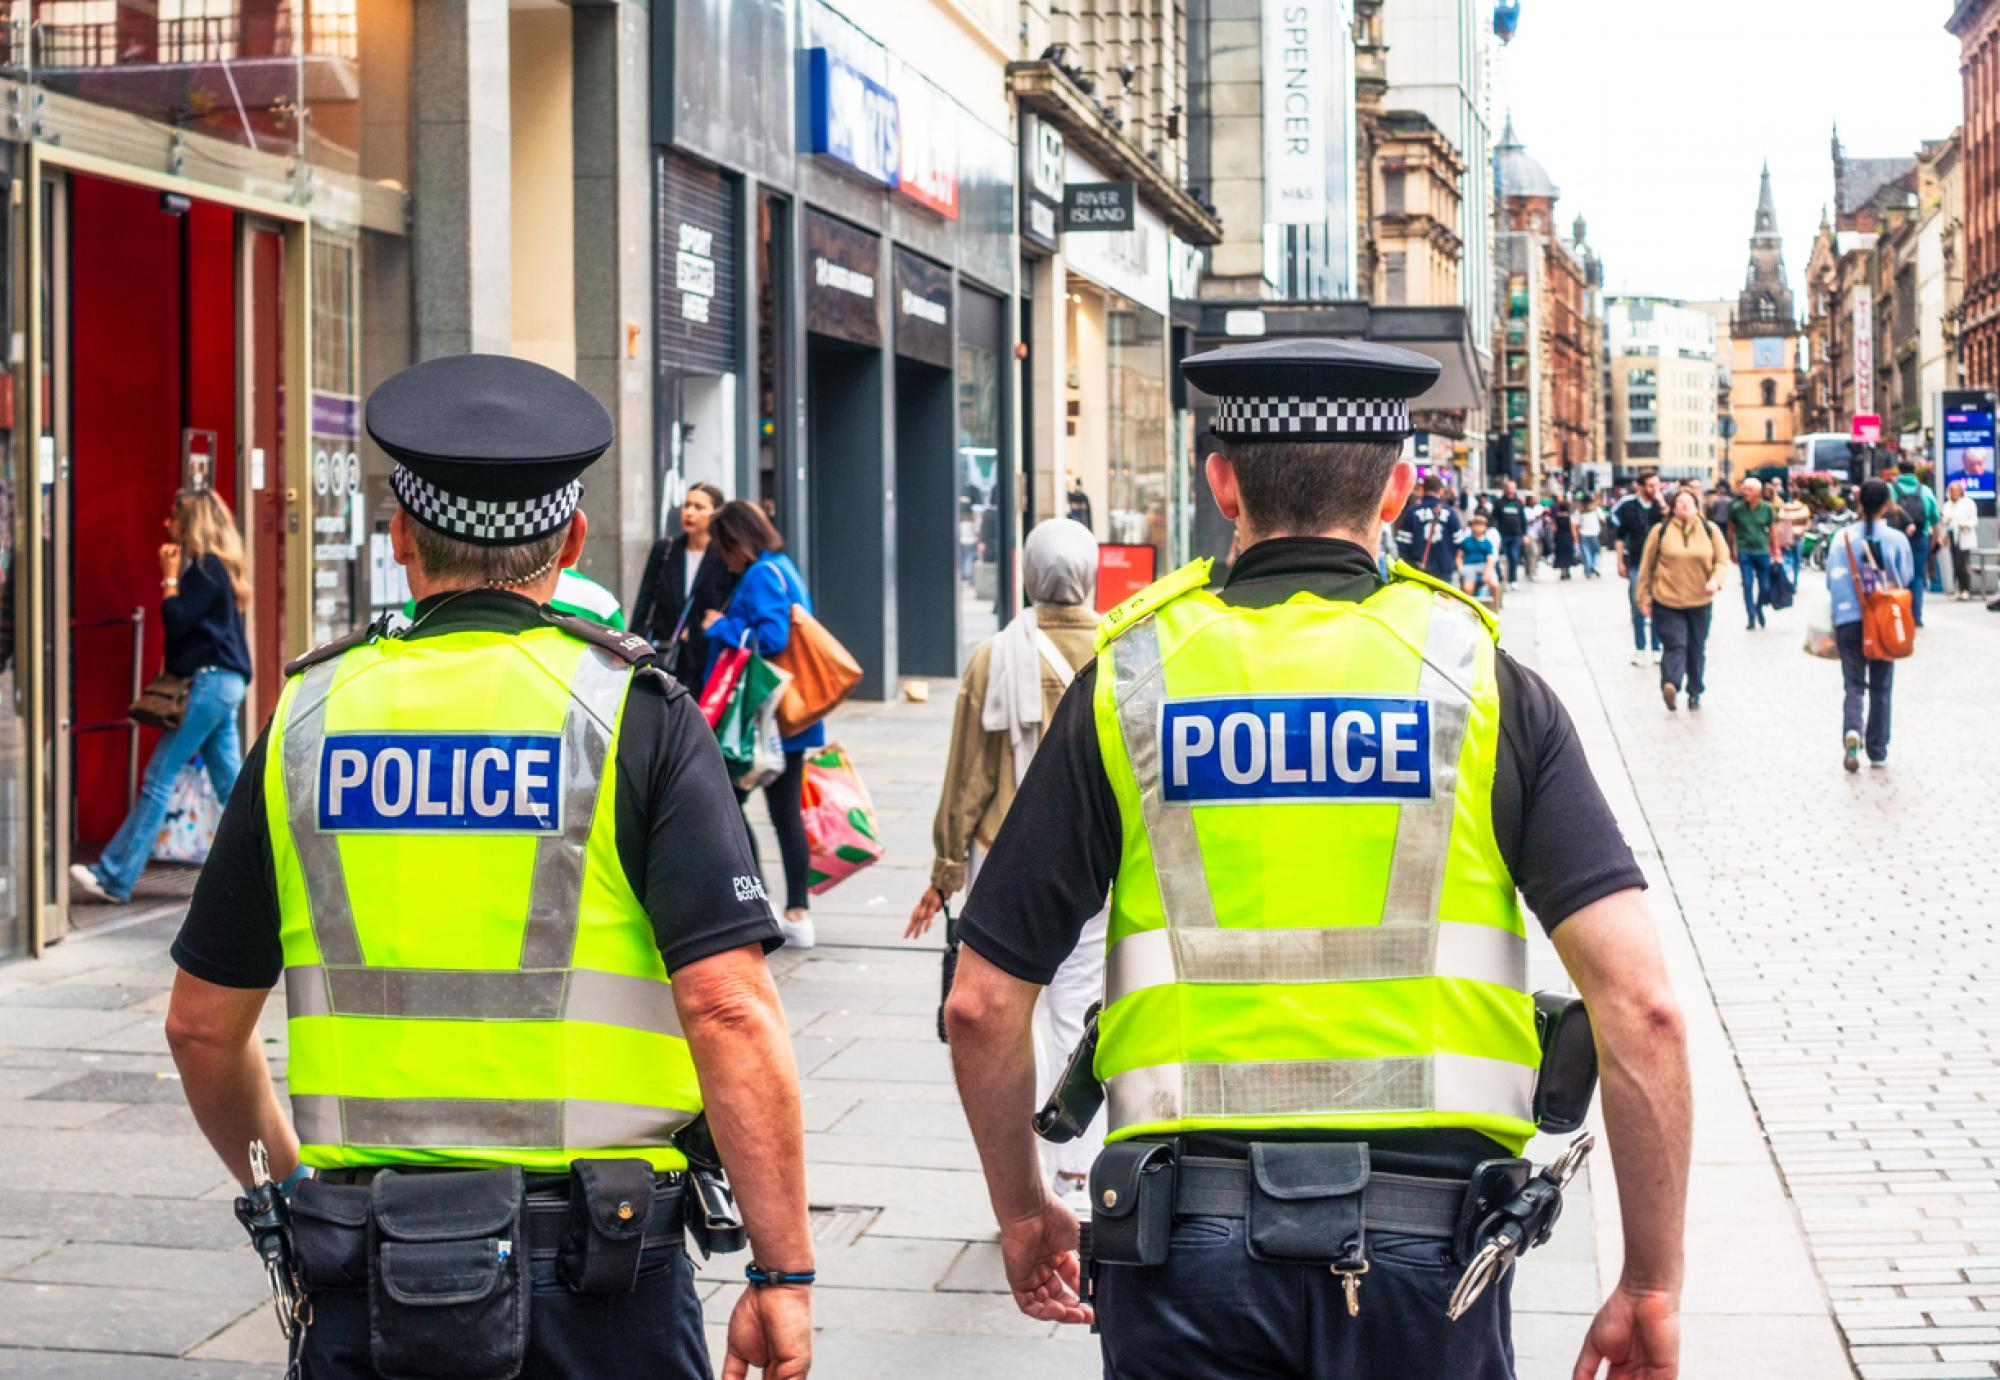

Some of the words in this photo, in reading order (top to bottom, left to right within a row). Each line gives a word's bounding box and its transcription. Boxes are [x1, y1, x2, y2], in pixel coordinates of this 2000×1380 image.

[1283, 7, 1309, 156] SPENCER
[1071, 207, 1125, 222] ISLAND
[1076, 190, 1120, 206] RIVER
[328, 747, 551, 818] POLICE
[1172, 709, 1420, 787] POLICE
